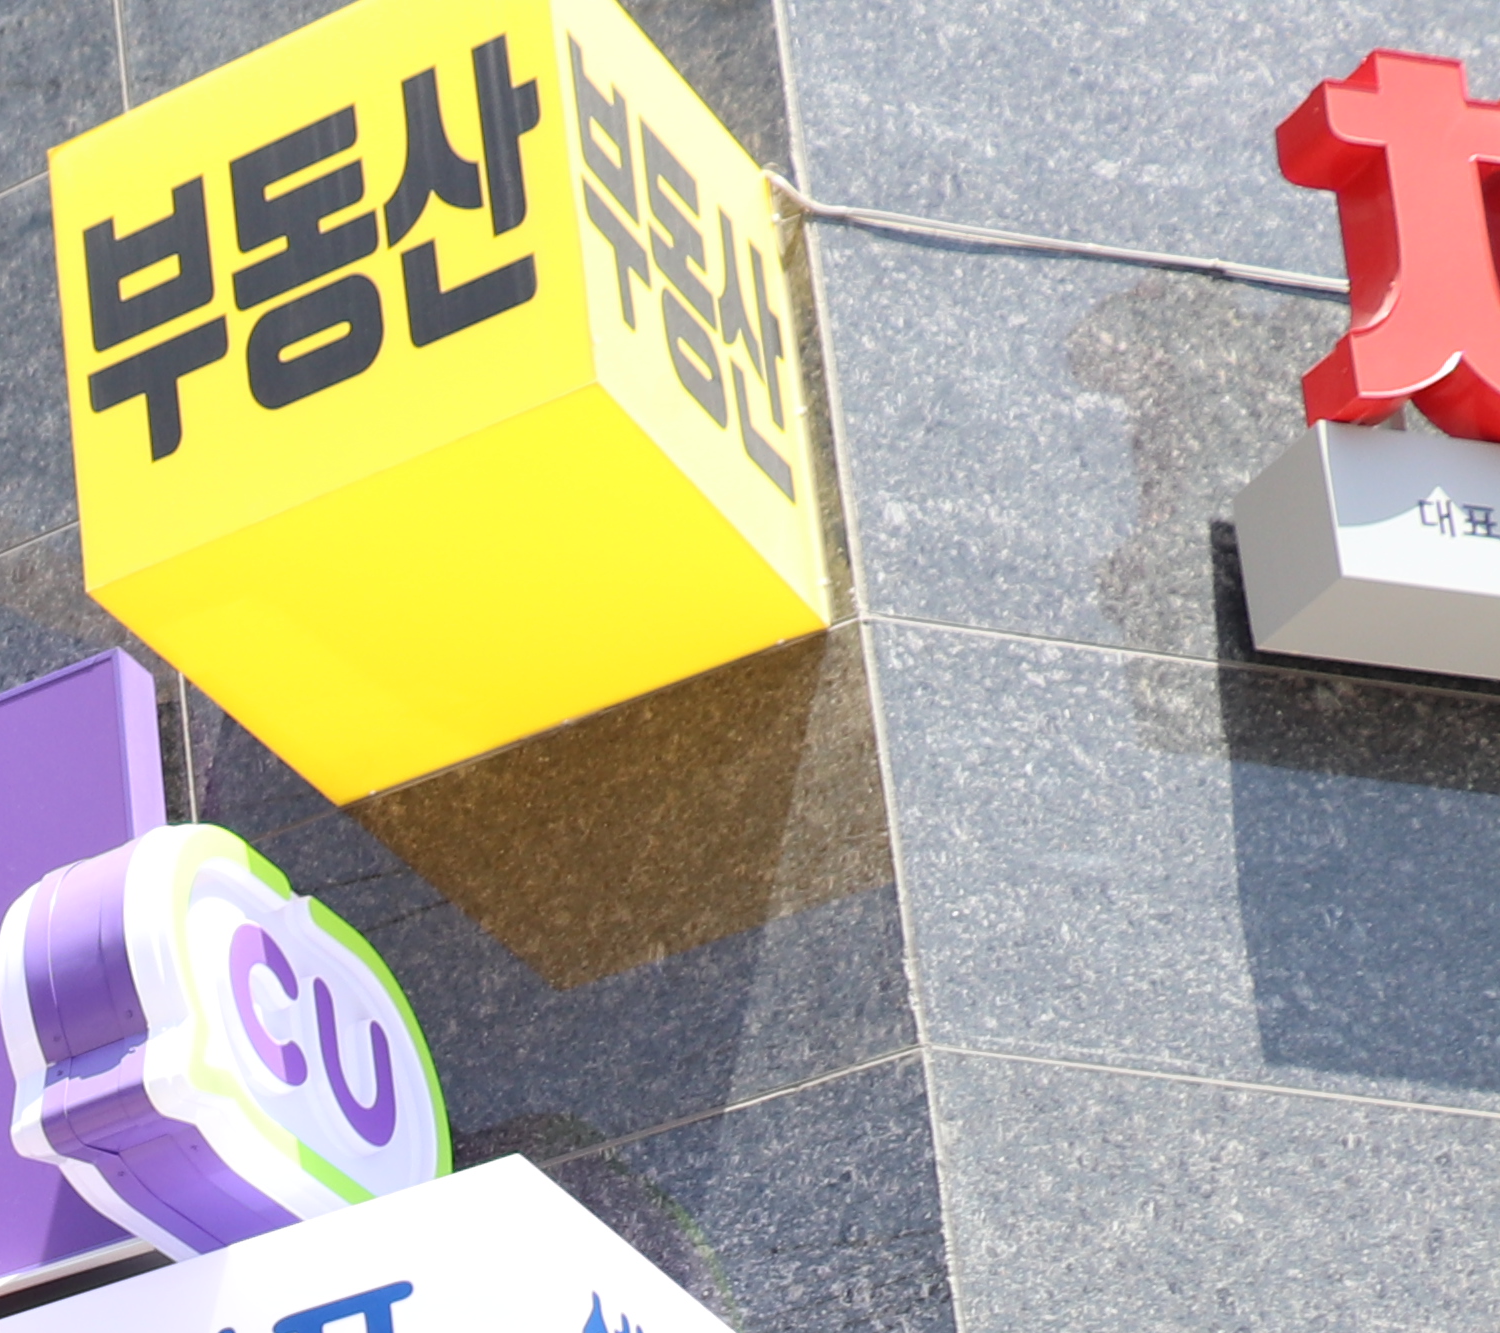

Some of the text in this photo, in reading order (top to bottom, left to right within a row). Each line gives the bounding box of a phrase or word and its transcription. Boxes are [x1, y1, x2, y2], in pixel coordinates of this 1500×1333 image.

[82, 31, 542, 464] 부동산
[566, 29, 798, 507] 부동산
[228, 922, 398, 1148] CU
